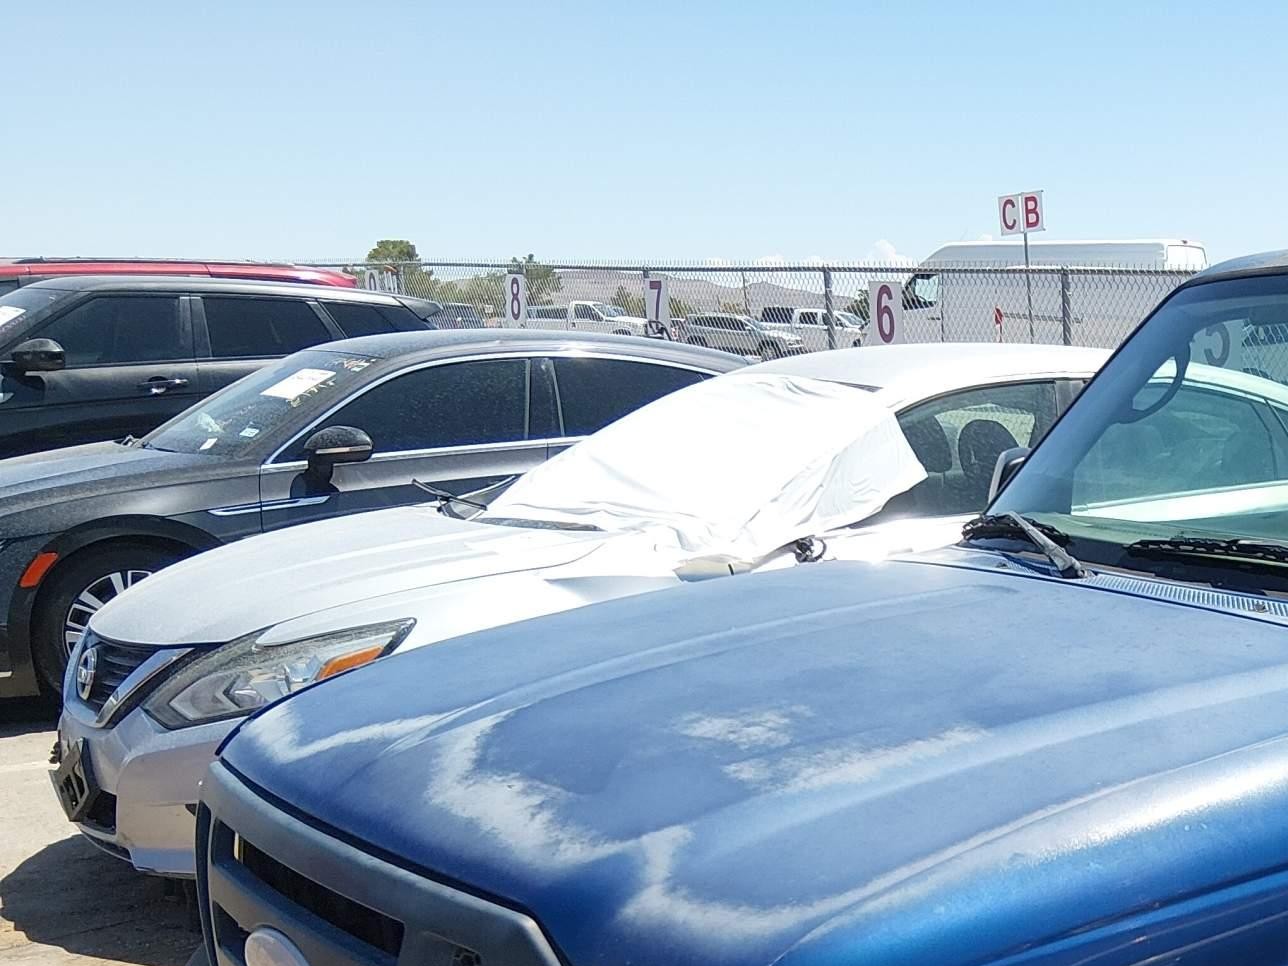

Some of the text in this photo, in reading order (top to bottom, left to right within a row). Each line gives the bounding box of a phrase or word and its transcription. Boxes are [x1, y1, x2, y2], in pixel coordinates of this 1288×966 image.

[1002, 195, 1040, 231] C B
[510, 276, 521, 321] 8
[649, 280, 662, 321] 7
[876, 284, 896, 343] 6
